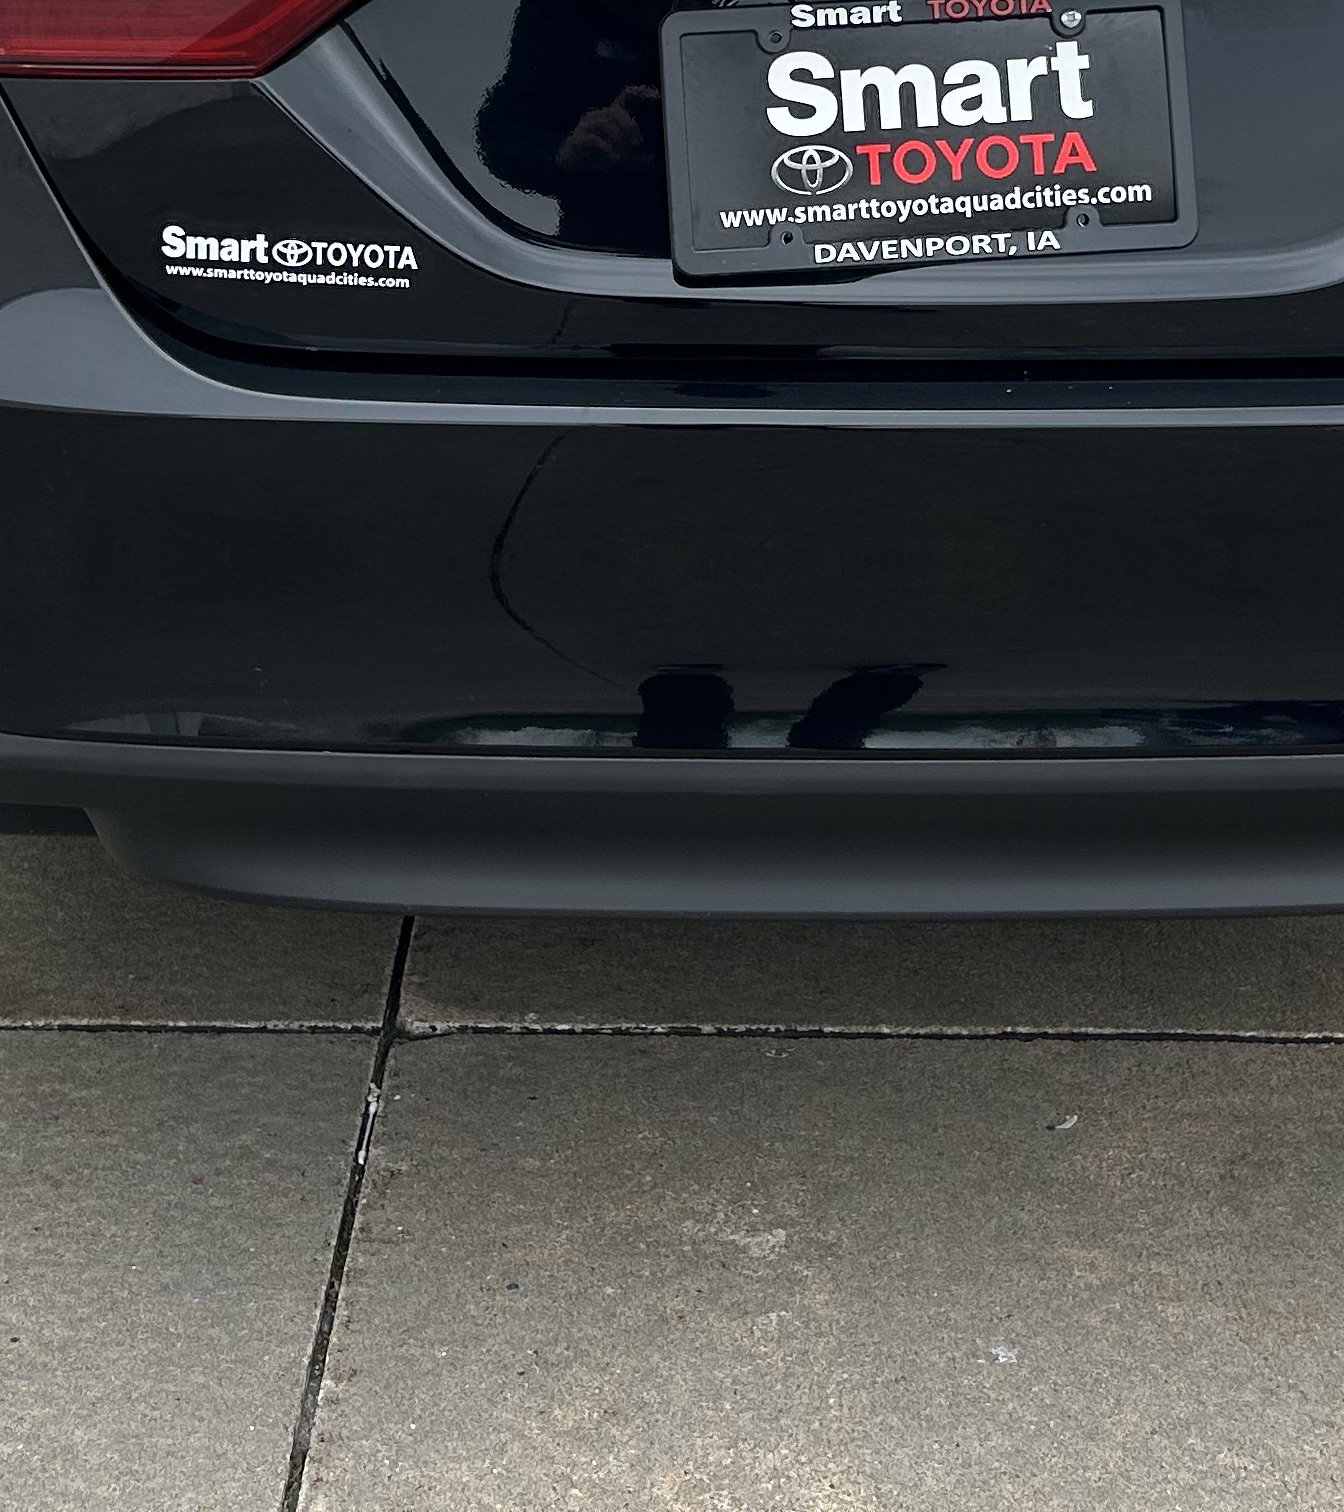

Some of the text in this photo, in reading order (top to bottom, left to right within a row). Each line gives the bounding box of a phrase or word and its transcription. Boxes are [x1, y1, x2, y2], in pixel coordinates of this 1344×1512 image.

[791, 0, 903, 29] Smart
[766, 40, 1095, 138] Smart
[855, 131, 1098, 186] TOYOTA
[719, 182, 1153, 229] www.smarttoyotaquadcities.com
[160, 225, 419, 271] Smart TOYOTA
[814, 230, 1061, 265] DAVENPORT, IA
[164, 264, 411, 289] www.smarttoyotaquadcities.com
